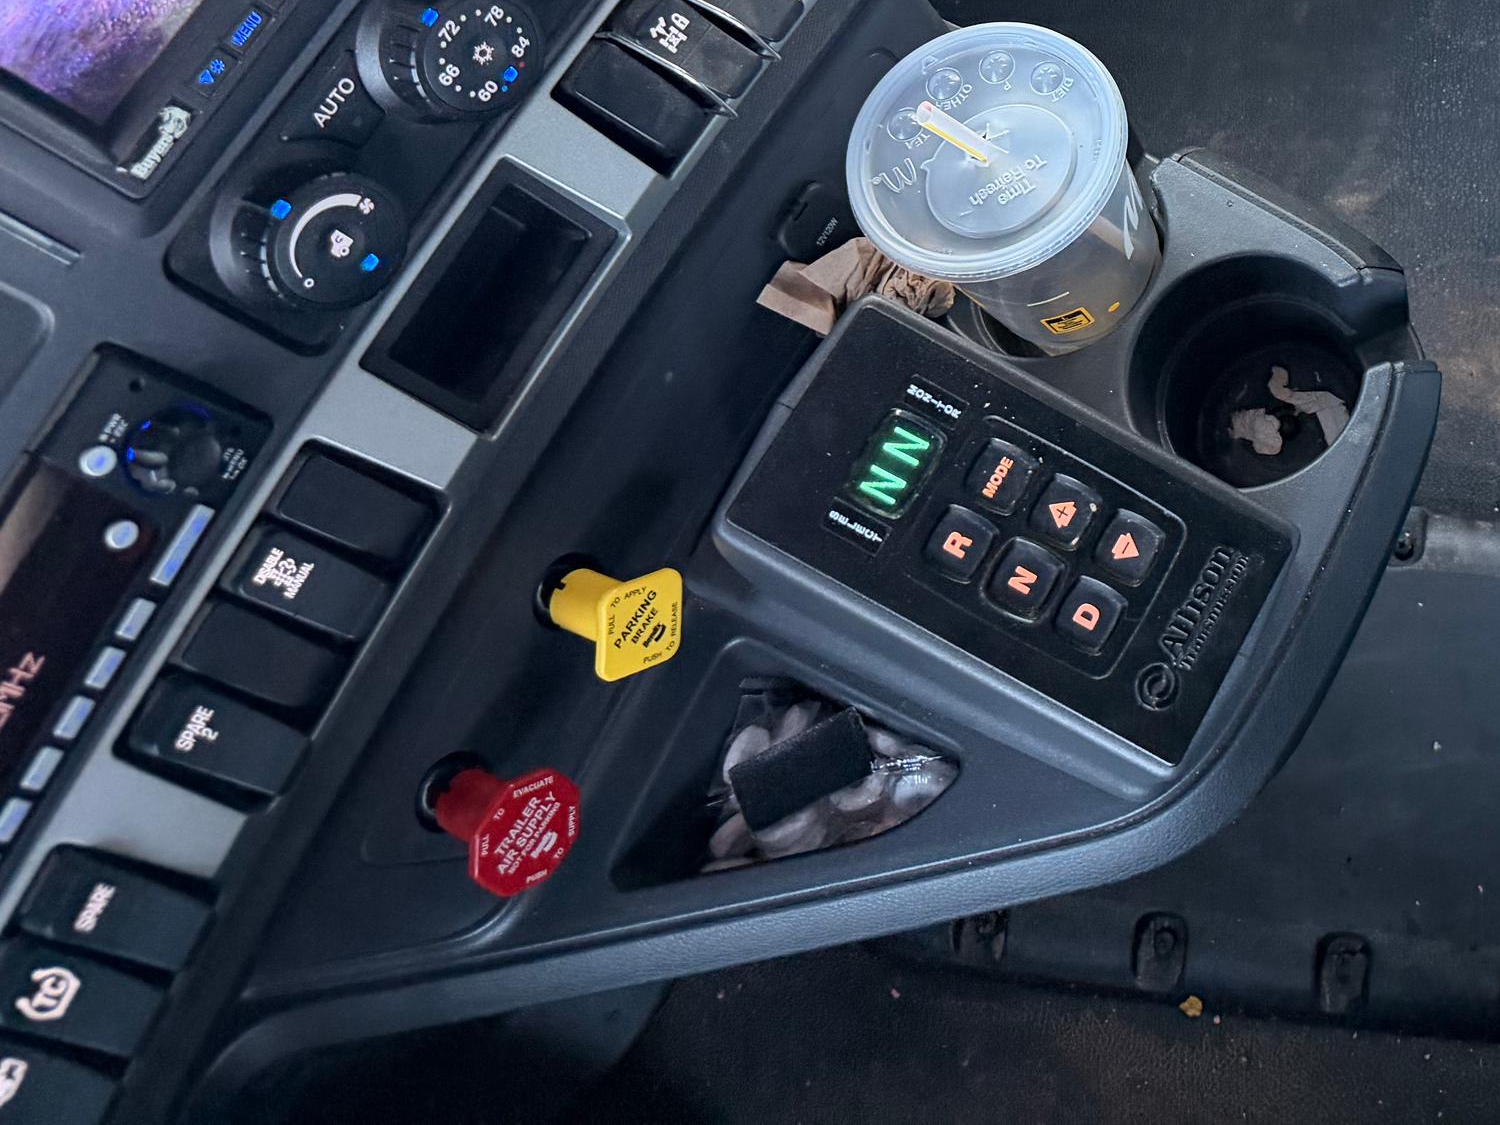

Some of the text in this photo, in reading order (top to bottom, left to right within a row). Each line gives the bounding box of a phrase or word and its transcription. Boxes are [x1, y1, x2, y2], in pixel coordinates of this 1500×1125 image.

[231, 11, 262, 47] MENU
[438, 20, 461, 42] 72
[484, 5, 504, 27] 78
[511, 36, 531, 59] 84
[439, 65, 460, 86] 66
[477, 80, 498, 102] 60
[1050, 78, 1074, 103] DIET
[313, 77, 356, 128] AUTO
[130, 135, 174, 180] Buyers
[968, 165, 1026, 207] Refresh
[998, 178, 1036, 206] Time
[906, 384, 962, 419] MONITOR
[982, 456, 1014, 499] MODE
[828, 510, 883, 542] SELECT
[942, 531, 973, 559] R
[253, 547, 284, 585] DISABLE
[283, 562, 315, 599] MANUAL
[1008, 565, 1038, 595] N
[610, 597, 620, 608] TO
[614, 590, 657, 649] PARKING
[1072, 603, 1100, 631] D
[1159, 547, 1233, 665] Allison
[631, 607, 658, 644] BRAKE
[666, 641, 675, 650] TO
[175, 705, 215, 751] SPARE
[200, 727, 219, 741] 2
[493, 808, 505, 820] TO
[513, 775, 554, 798] EVACUATE
[494, 796, 541, 856] TRAILER
[497, 791, 556, 874] AIR SUPPLY
[508, 801, 561, 875] NOT FOR PARKING
[554, 847, 564, 859] TO
[73, 883, 117, 932] SPARE
